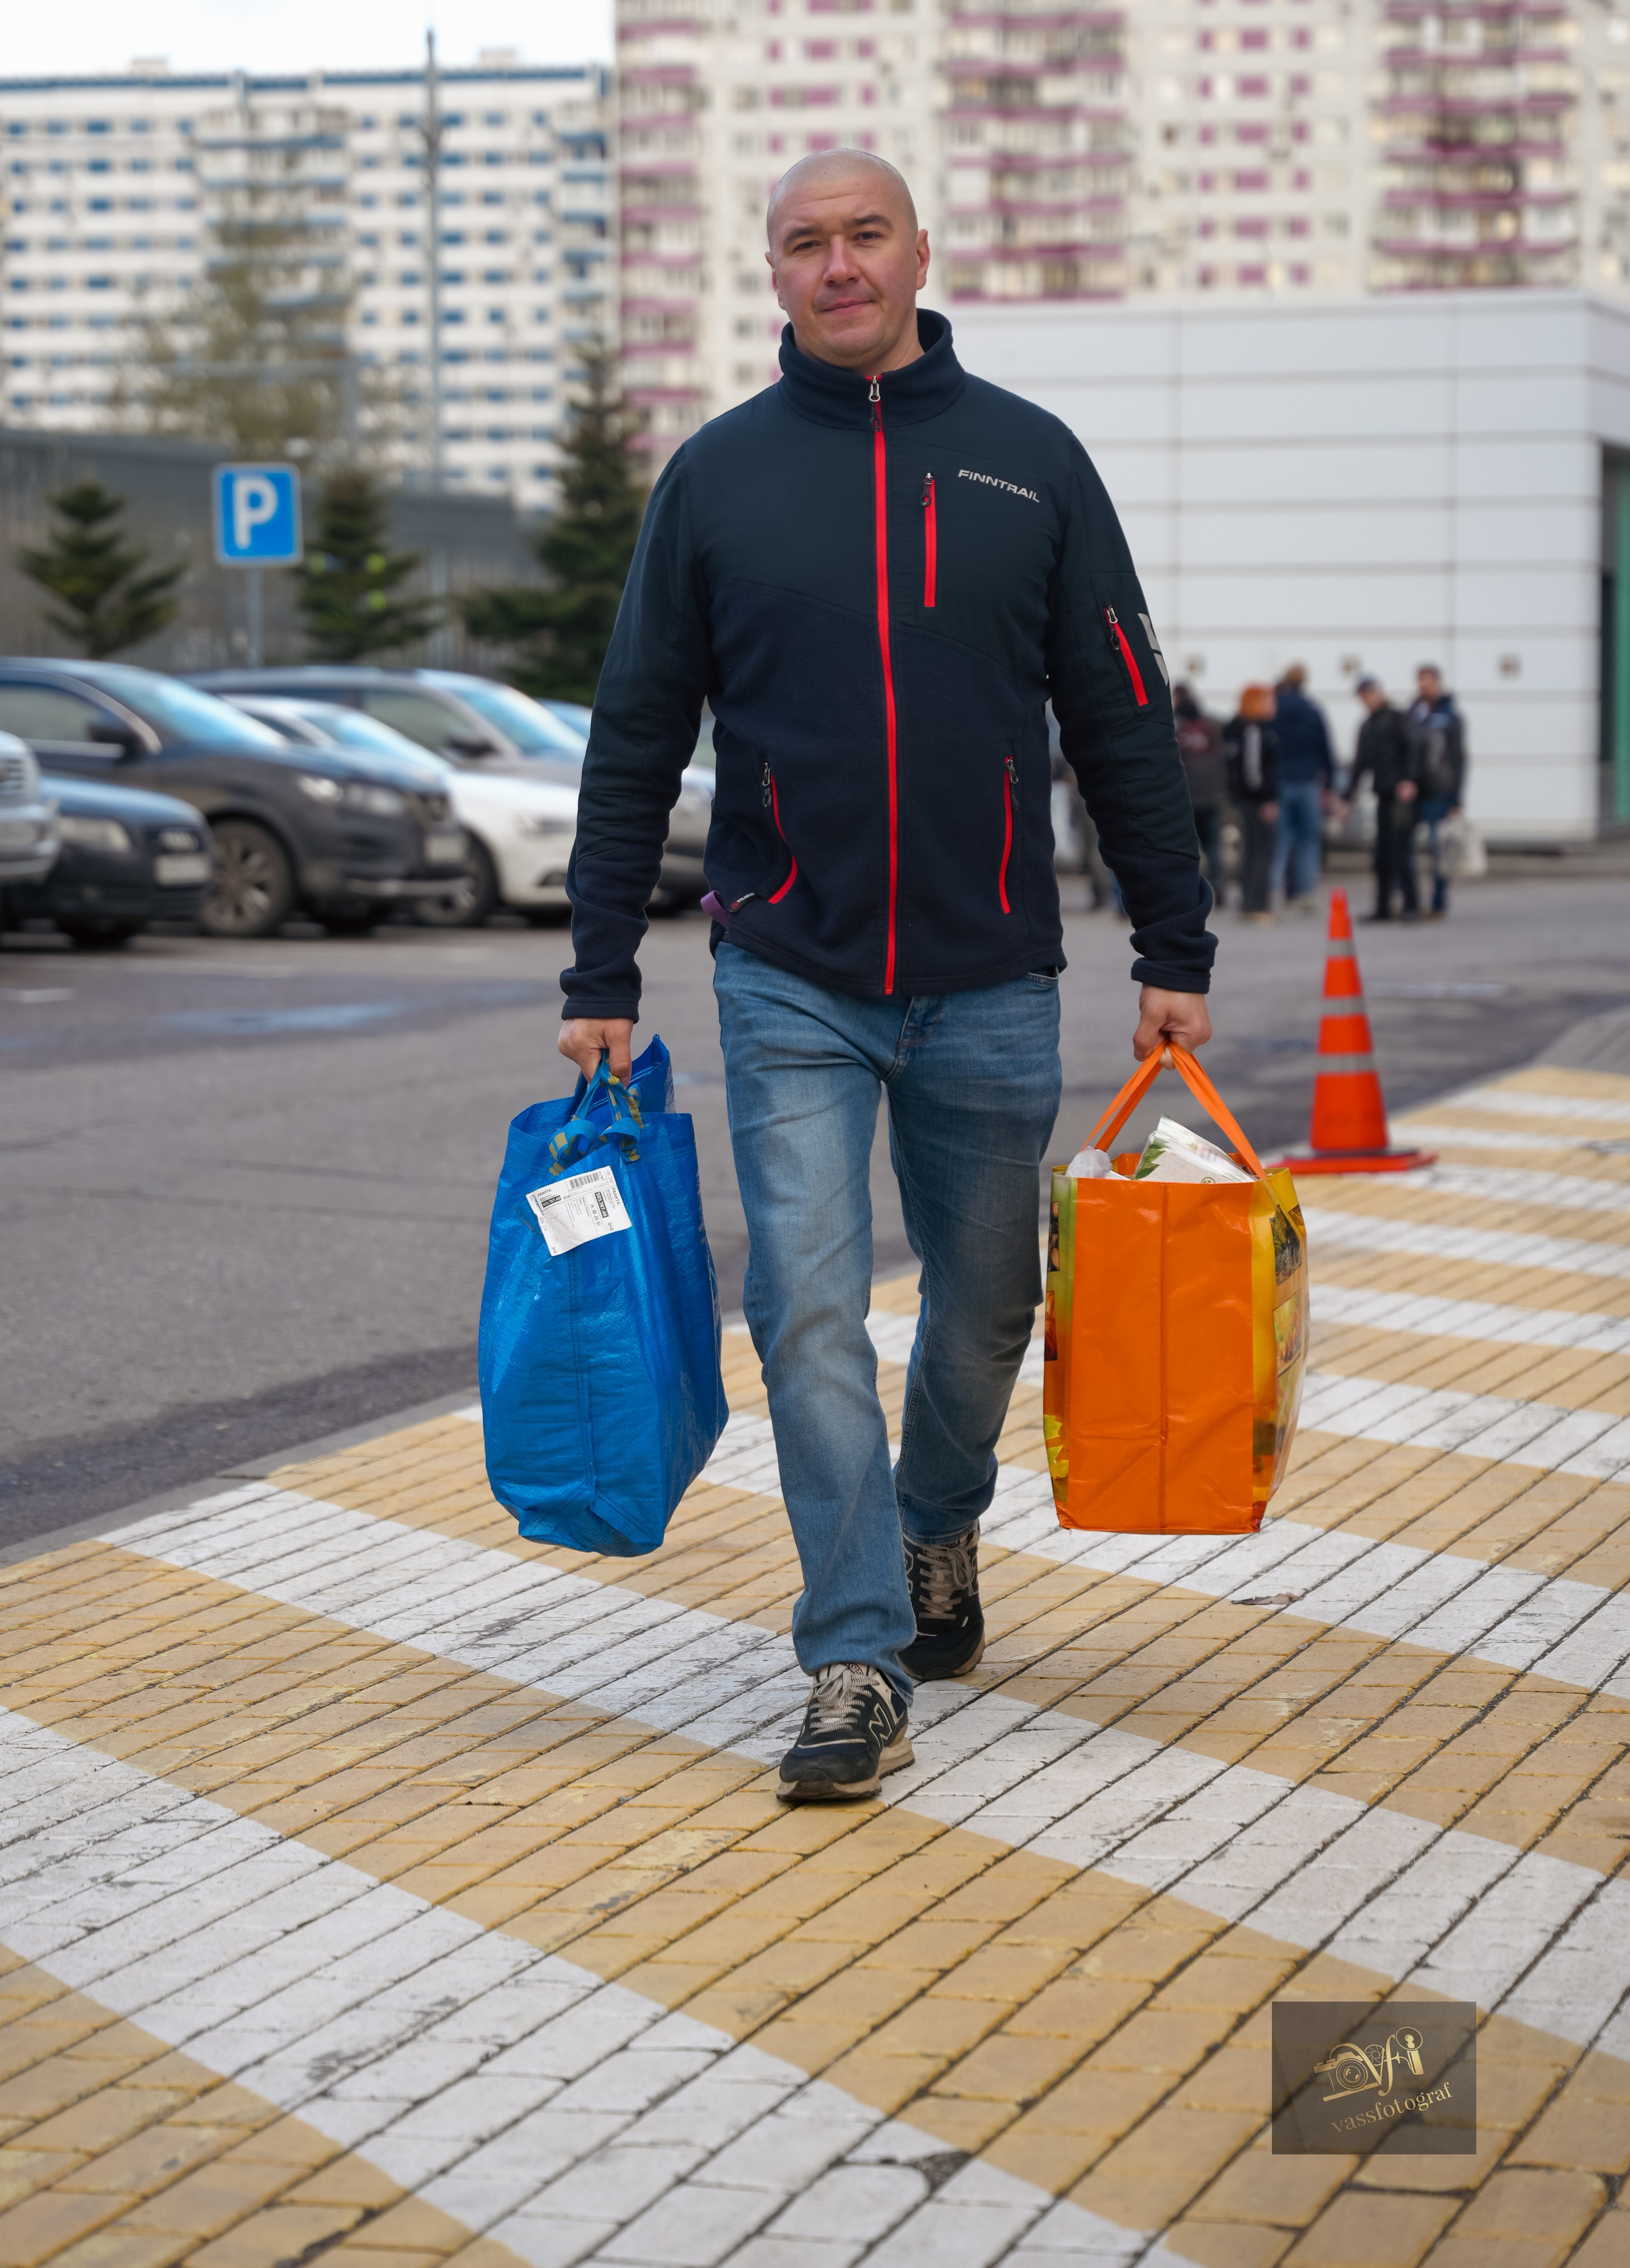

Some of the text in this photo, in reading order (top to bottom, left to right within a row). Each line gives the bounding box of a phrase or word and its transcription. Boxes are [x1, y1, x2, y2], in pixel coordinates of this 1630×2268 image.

[958, 469, 1040, 503] FINNTRAIL
[232, 476, 278, 550] P
[537, 1188, 552, 1197] FRAKTA
[595, 1192, 608, 1218] 503.787.40
[612, 1187, 620, 1206] FRAKTA
